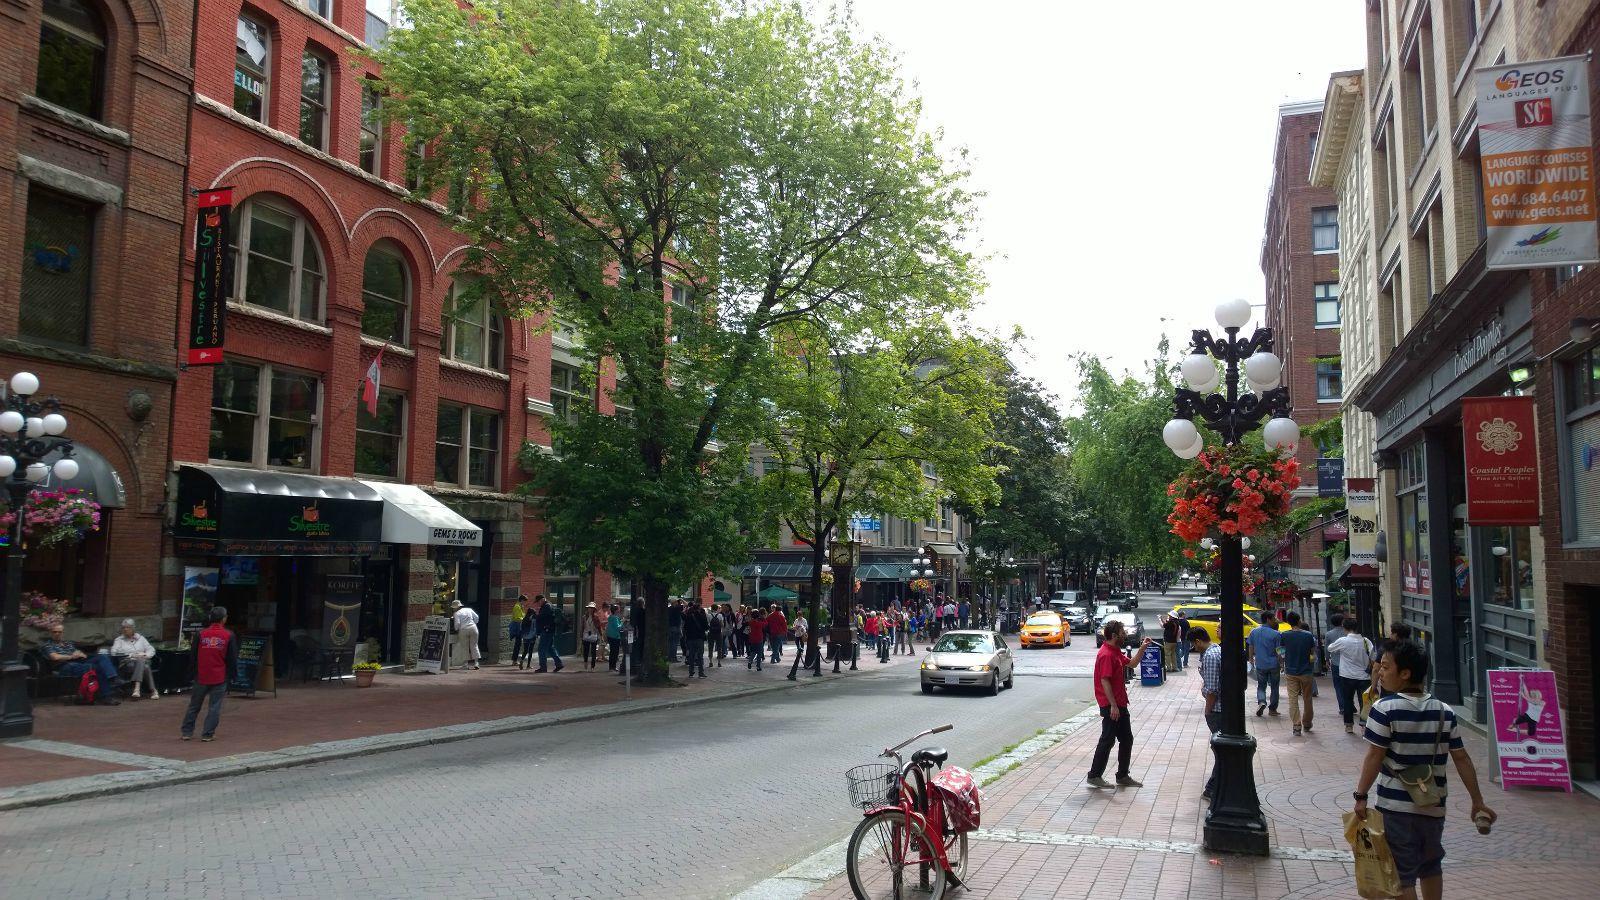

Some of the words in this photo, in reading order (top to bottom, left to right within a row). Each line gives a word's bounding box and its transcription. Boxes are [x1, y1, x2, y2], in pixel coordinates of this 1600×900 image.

[1496, 69, 1564, 91] GEOS
[1486, 87, 1548, 100] LANGUAGES
[1486, 155, 1541, 170] LANGUAGE
[1542, 152, 1588, 165] COURSES
[1487, 165, 1590, 188] WORLDWIDE
[1491, 189, 1588, 206] 604.684.6407
[1492, 203, 1590, 220] www.geos.net
[1470, 465, 1502, 474] Coastal
[1503, 465, 1536, 475] Peoples
[433, 529, 451, 538] GEMS
[452, 530, 456, 538] &
[458, 530, 477, 540] ROCKS
